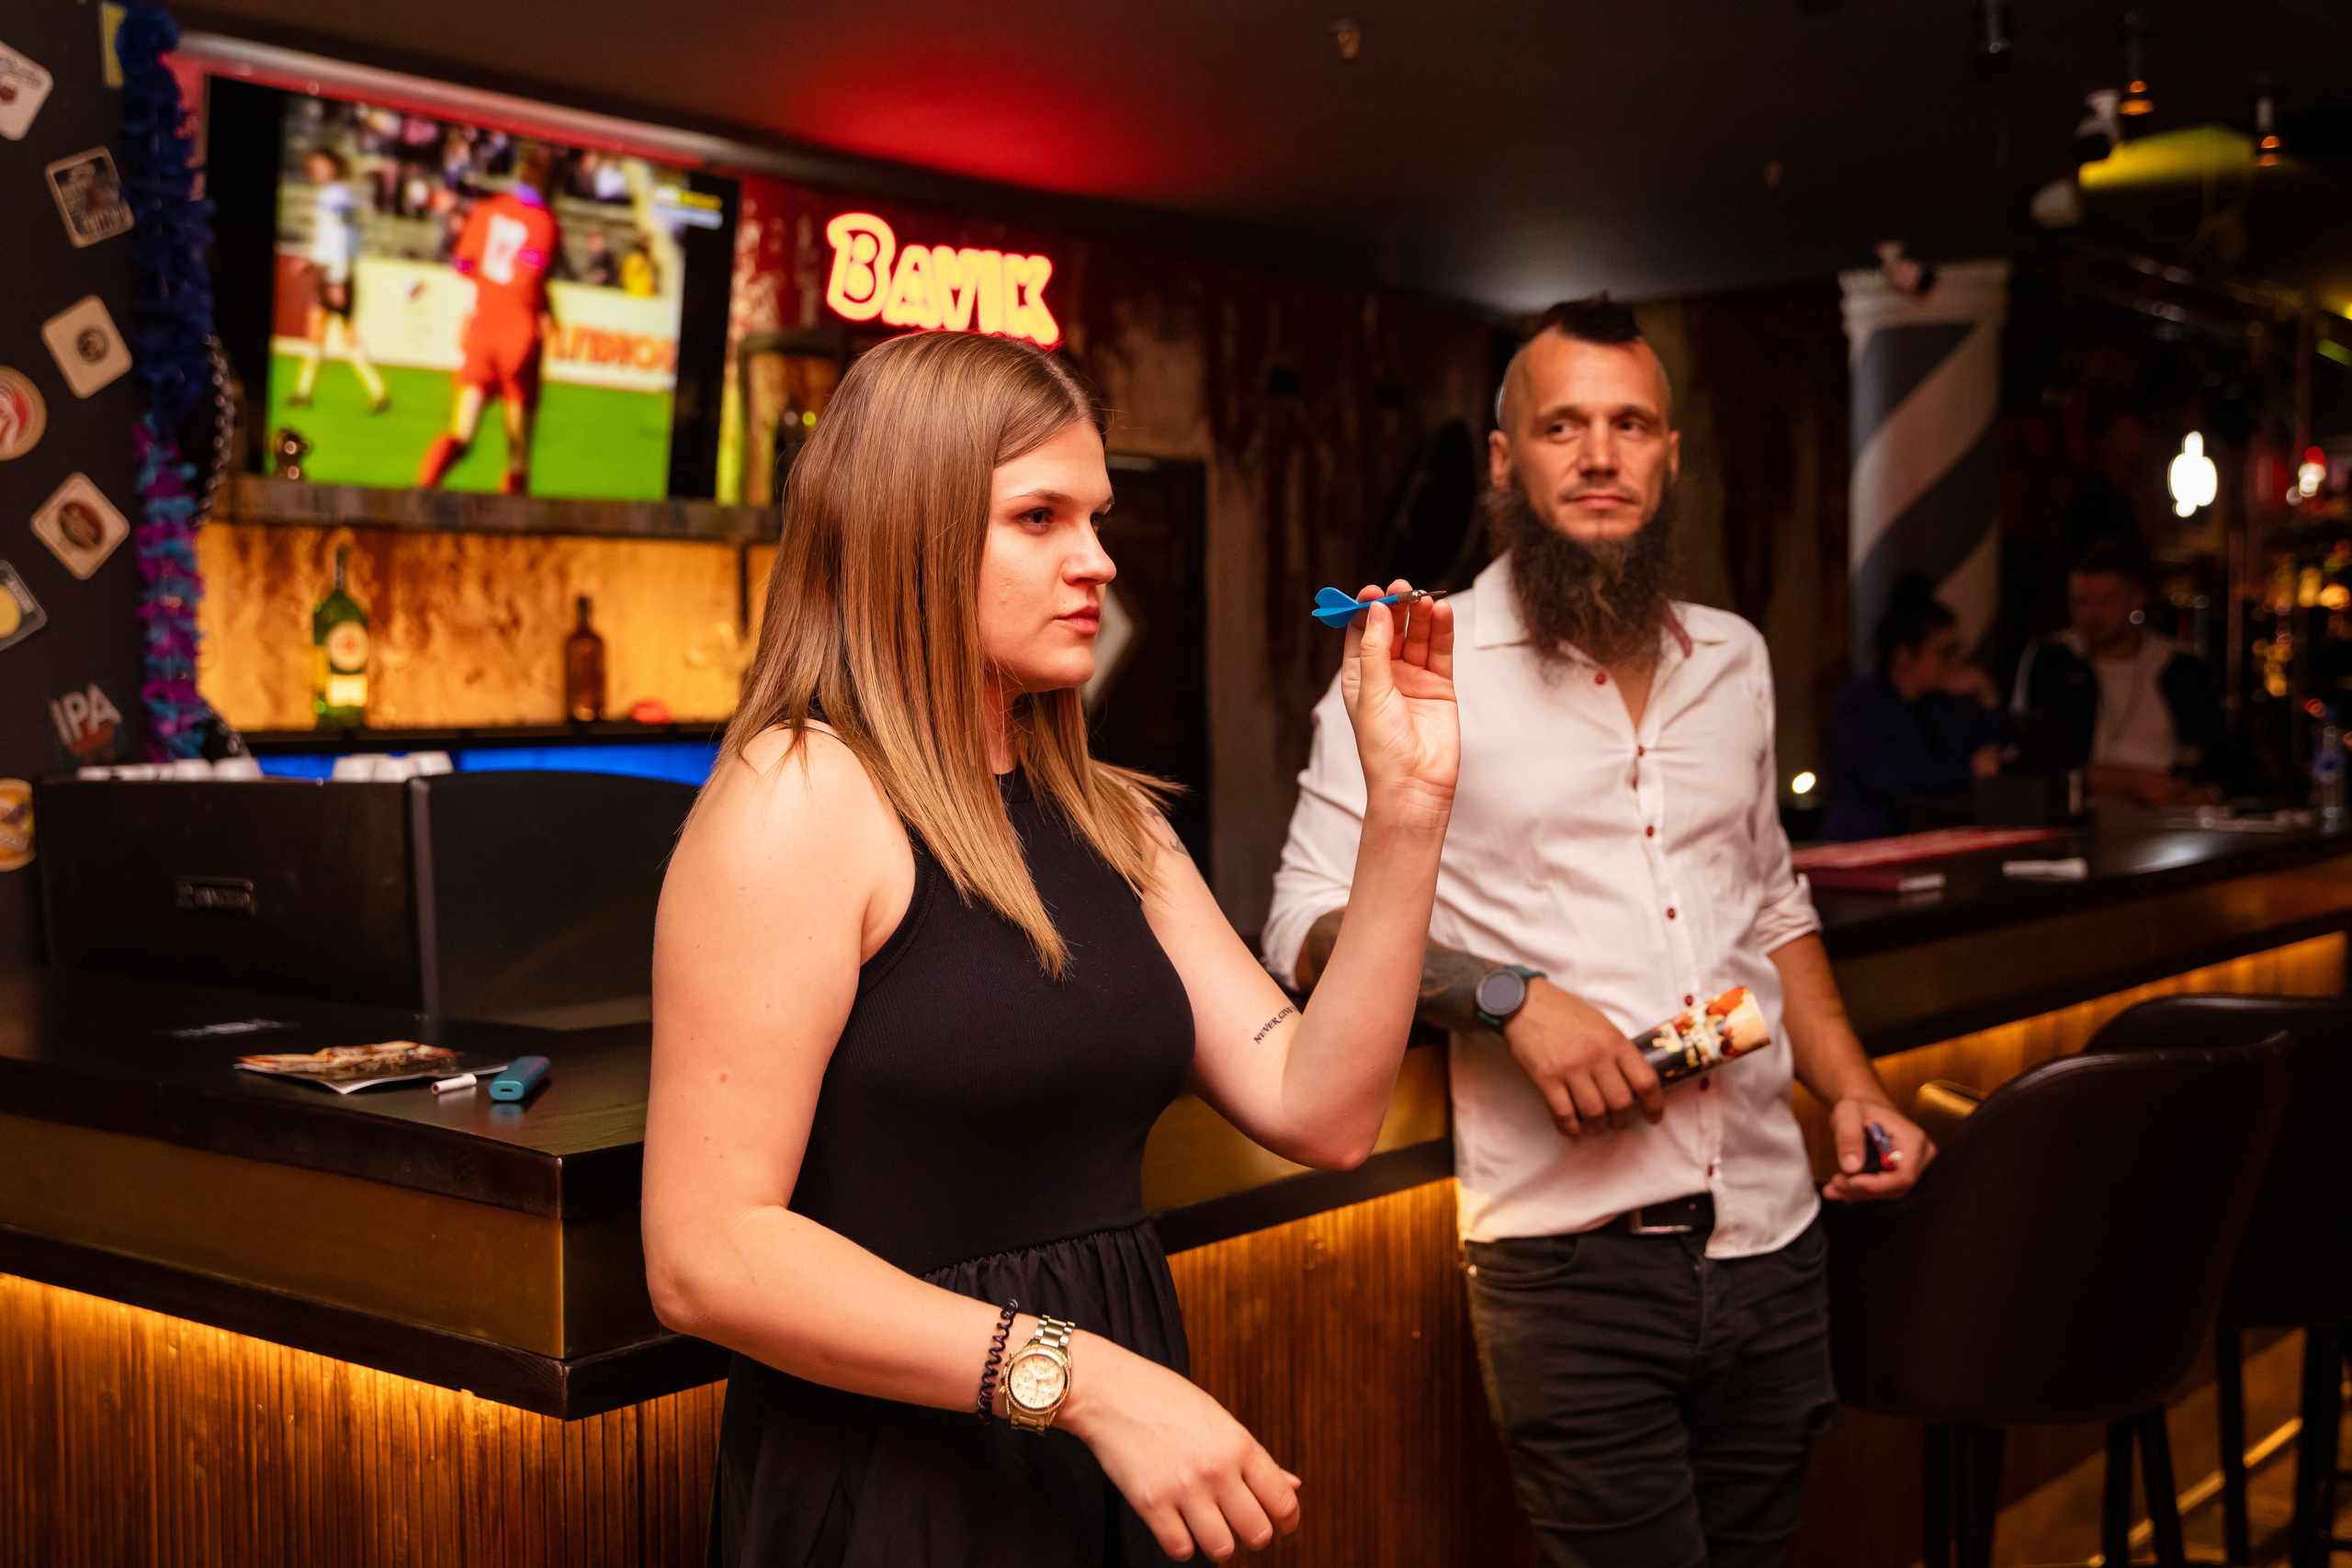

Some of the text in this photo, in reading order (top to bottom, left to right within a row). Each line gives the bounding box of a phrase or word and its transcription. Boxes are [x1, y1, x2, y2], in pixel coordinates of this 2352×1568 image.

[50, 682, 124, 746] IPA
[1253, 1006, 1294, 1045] NEVER GIVE
